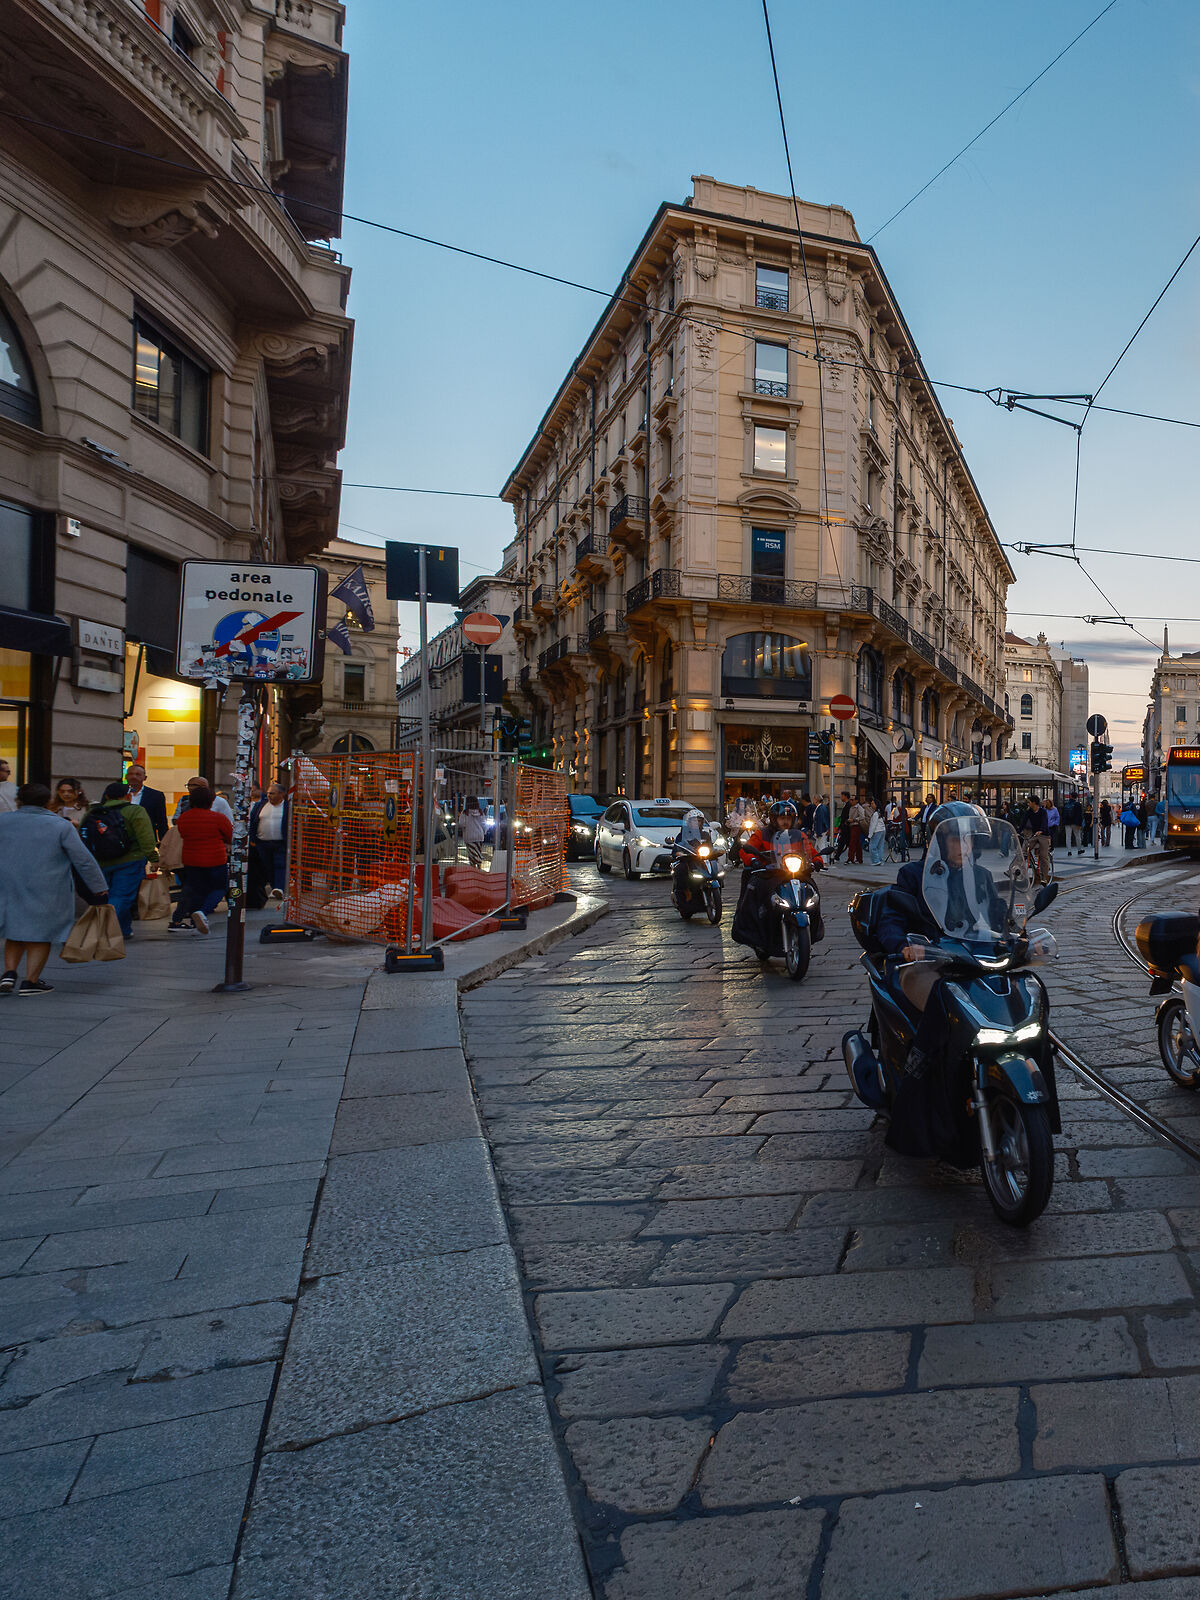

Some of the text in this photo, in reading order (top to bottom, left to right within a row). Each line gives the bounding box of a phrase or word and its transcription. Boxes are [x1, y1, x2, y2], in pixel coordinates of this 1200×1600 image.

[765, 542, 781, 550] RSM
[230, 572, 271, 584] area
[205, 589, 293, 603] pedonale
[84, 633, 119, 650] DANTE
